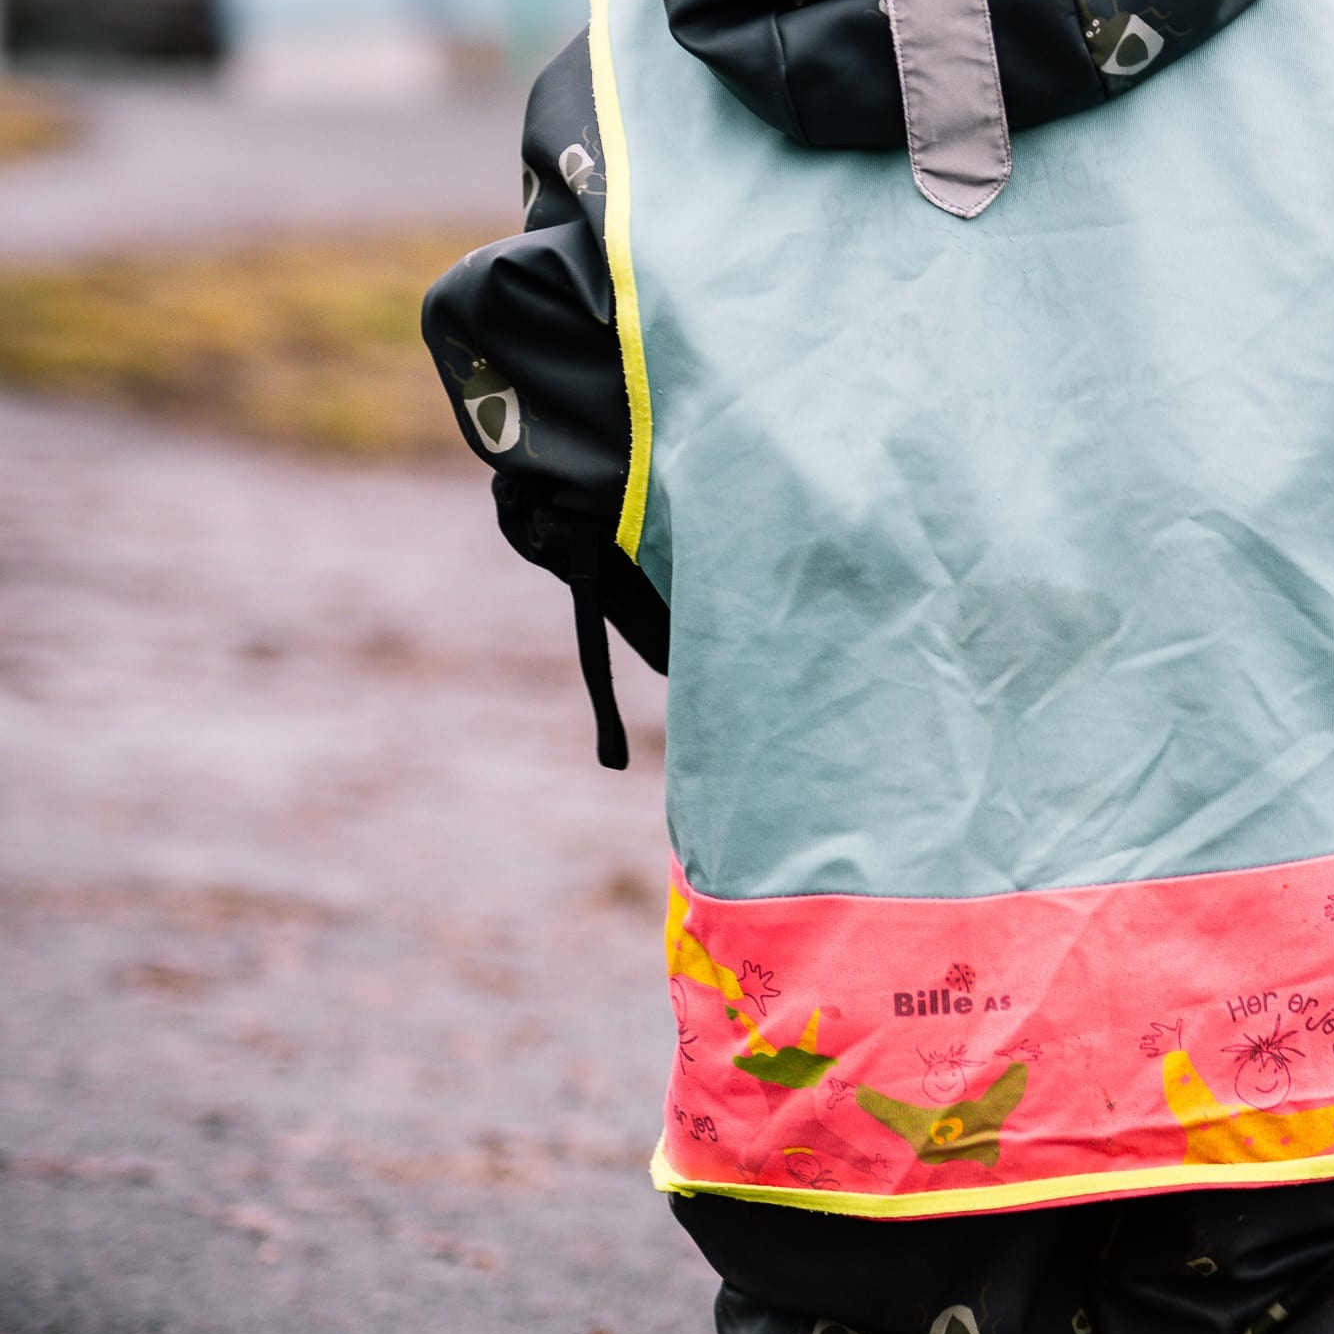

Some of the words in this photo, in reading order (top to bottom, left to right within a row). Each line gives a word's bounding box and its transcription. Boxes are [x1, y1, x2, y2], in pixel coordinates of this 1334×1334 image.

[893, 989, 974, 1017] Bille
[983, 995, 1012, 1013] AS
[1226, 991, 1279, 1023] Her
[1288, 993, 1319, 1015] er
